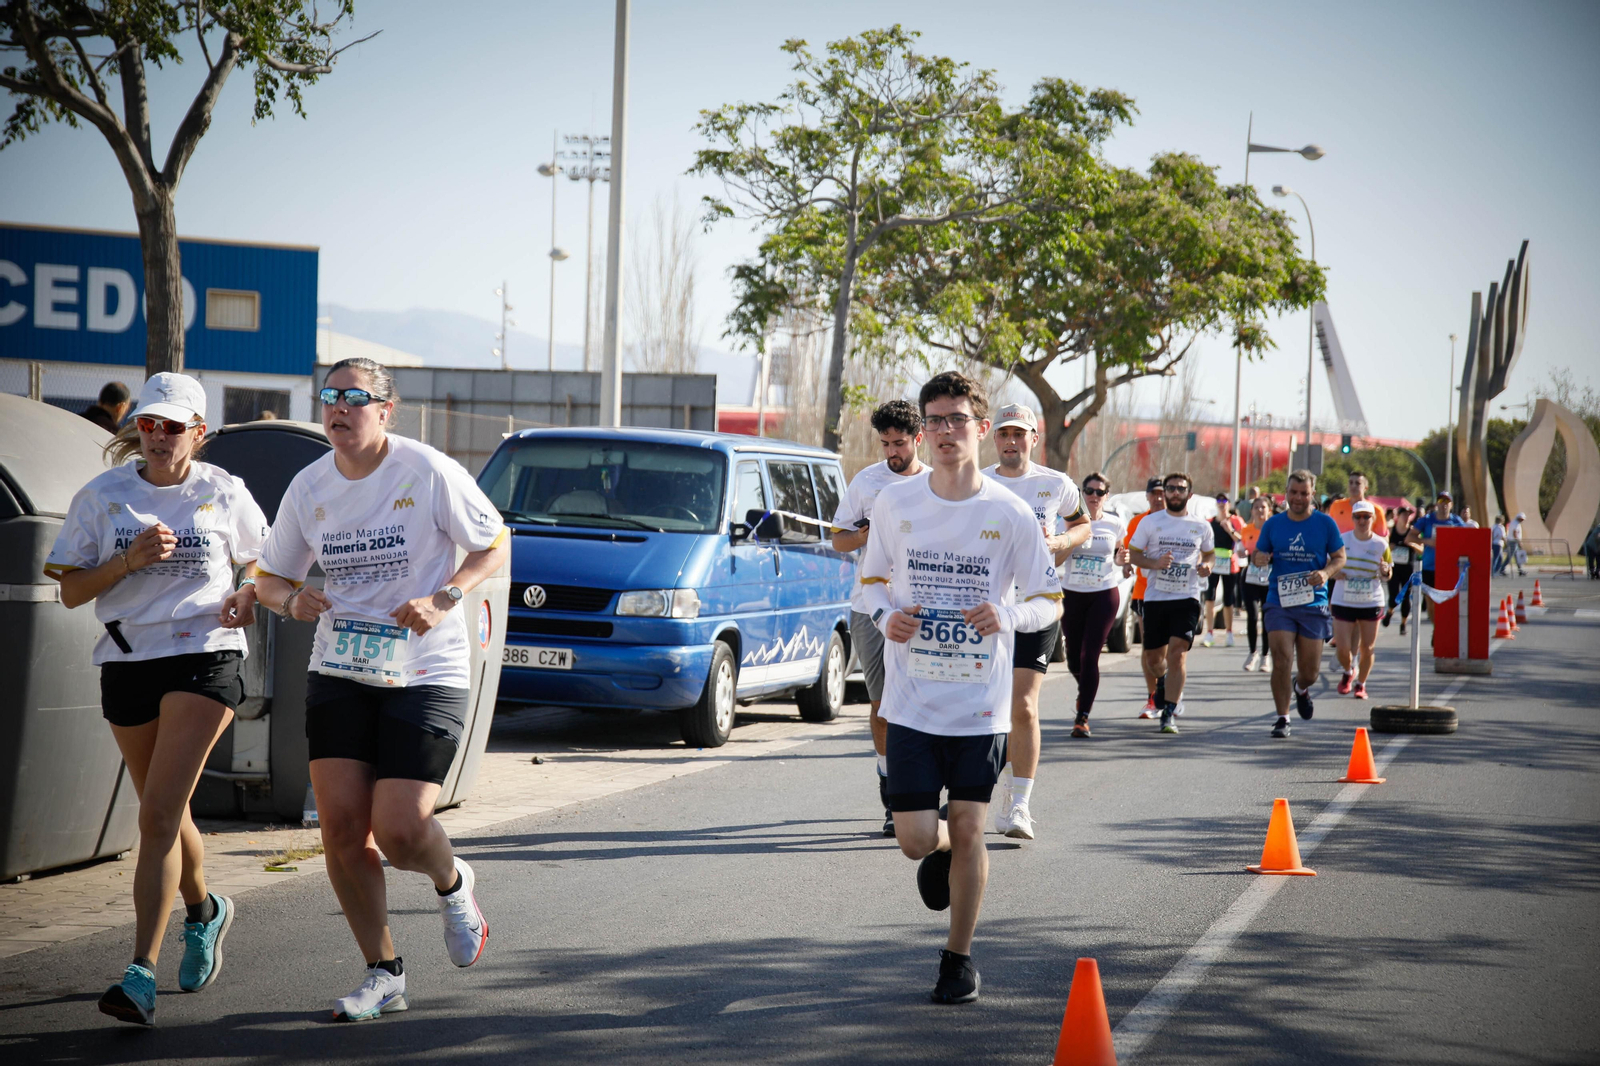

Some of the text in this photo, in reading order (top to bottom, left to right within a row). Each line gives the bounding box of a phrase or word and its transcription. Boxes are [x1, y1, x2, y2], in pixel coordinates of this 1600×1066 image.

[1002, 411, 1025, 419] LALIGA
[115, 526, 210, 537] Medi aratón
[321, 524, 405, 542] Medio Maratón
[176, 536, 210, 548] 2024
[322, 535, 405, 555] Almería 2024
[323, 557, 348, 566] RAMÓN
[370, 550, 408, 562] ANDÚJAR
[906, 548, 990, 564] Medio Maratón
[908, 559, 990, 577] Almería 2024
[1075, 559, 1102, 571] 5281
[1161, 566, 1188, 577] 5284
[935, 576, 953, 584] RUIZ
[1281, 577, 1308, 590] 5790
[920, 620, 983, 645] 5663
[335, 632, 396, 661] 5151
[352, 656, 370, 664] MARI
[502, 648, 567, 666] 386 CZW
